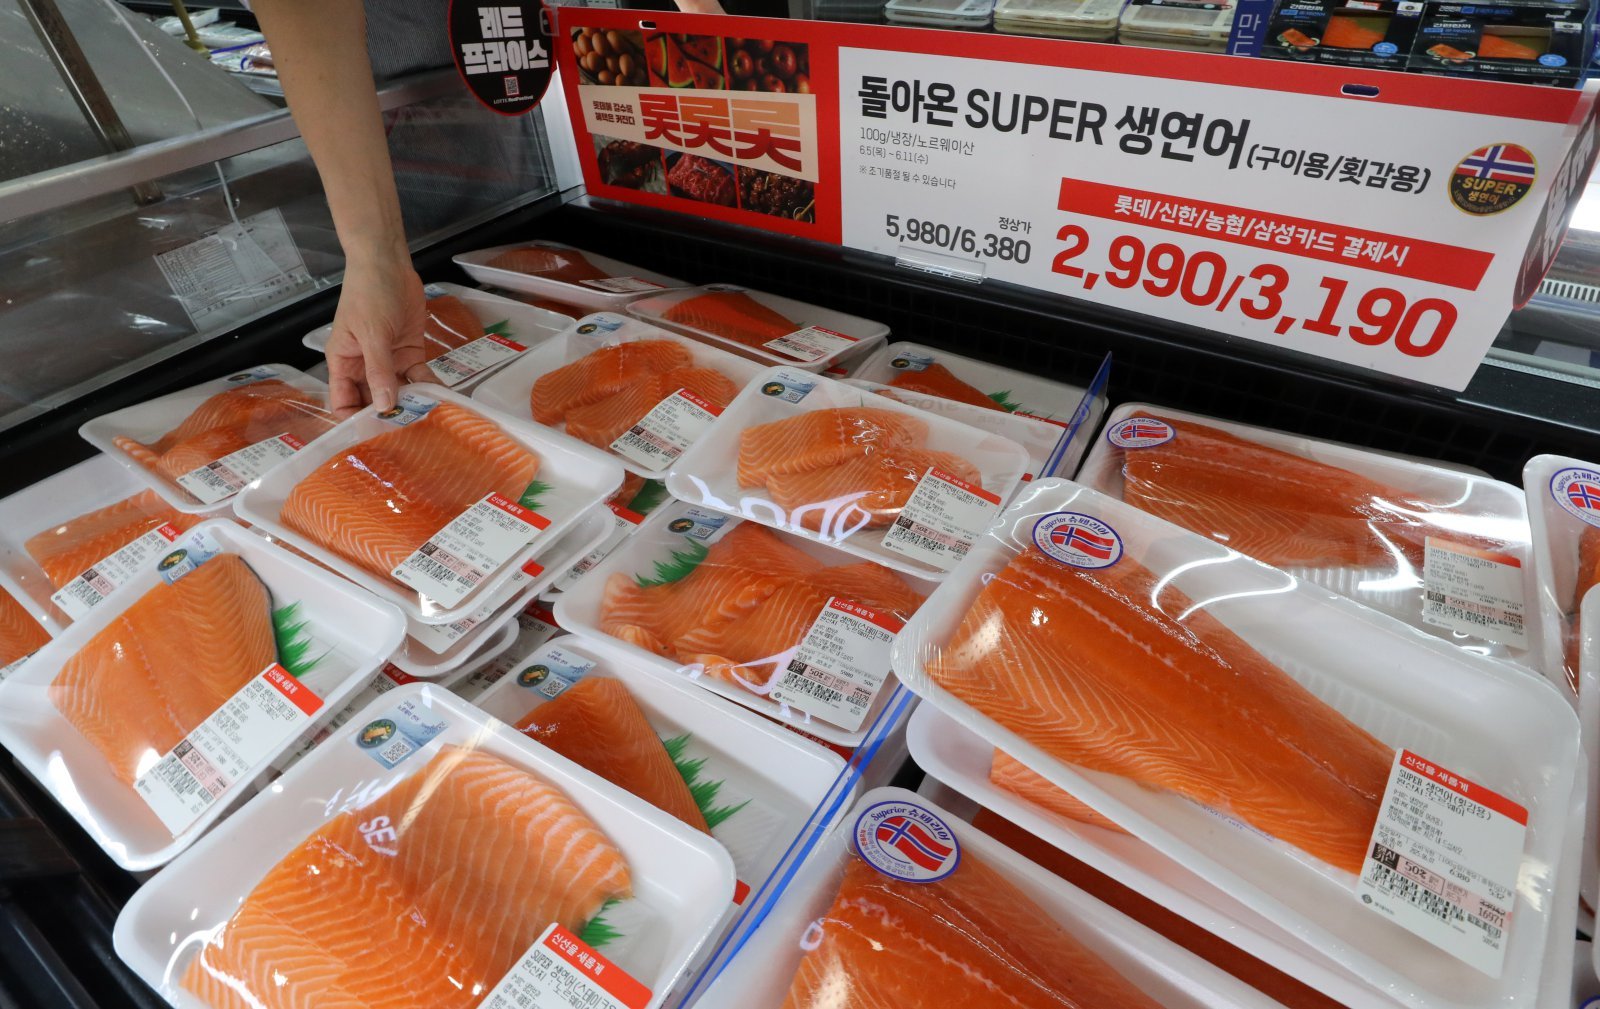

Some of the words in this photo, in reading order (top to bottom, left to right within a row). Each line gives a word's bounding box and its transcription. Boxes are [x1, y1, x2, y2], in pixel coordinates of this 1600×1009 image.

[478, 6, 525, 39] 레드
[462, 39, 549, 75] 프라이스
[858, 75, 958, 127] 돌아온
[965, 88, 1108, 146] SUPER
[860, 127, 975, 156] 100g/냉장/노르웨이산
[869, 166, 901, 181] 조기품절
[902, 171, 911, 182] 될
[912, 173, 921, 183] 수
[922, 174, 956, 190] 있습니다
[1462, 177, 1517, 195] SUPER
[886, 213, 1032, 265] 5,980/6,380
[999, 216, 1032, 235] 정상가
[1113, 194, 1335, 254] 롯데/신한/농협/삼성카드
[1341, 233, 1410, 269] 결제시
[1051, 224, 1458, 358] 2,990/3,190
[833, 599, 853, 611] 신선을
[852, 606, 875, 619] 새롭게
[267, 668, 284, 683] 신선을
[280, 679, 298, 694] 새롭게
[808, 667, 824, 679] 50%
[1405, 754, 1435, 776] 신선을
[1438, 771, 1468, 793] 새롭게
[1399, 769, 1421, 786] SUPER
[1424, 780, 1491, 822] 생연어(횟감용)
[871, 806, 907, 821] Superior
[1404, 861, 1426, 879] 50%
[1449, 868, 1469, 883] 6380
[1489, 888, 1503, 901] 532
[1478, 906, 1503, 928] 16971
[530, 949, 553, 969] SUPER
[551, 933, 579, 957] 신선을
[577, 949, 605, 976] 새롭게
[521, 959, 547, 982] 원산지
